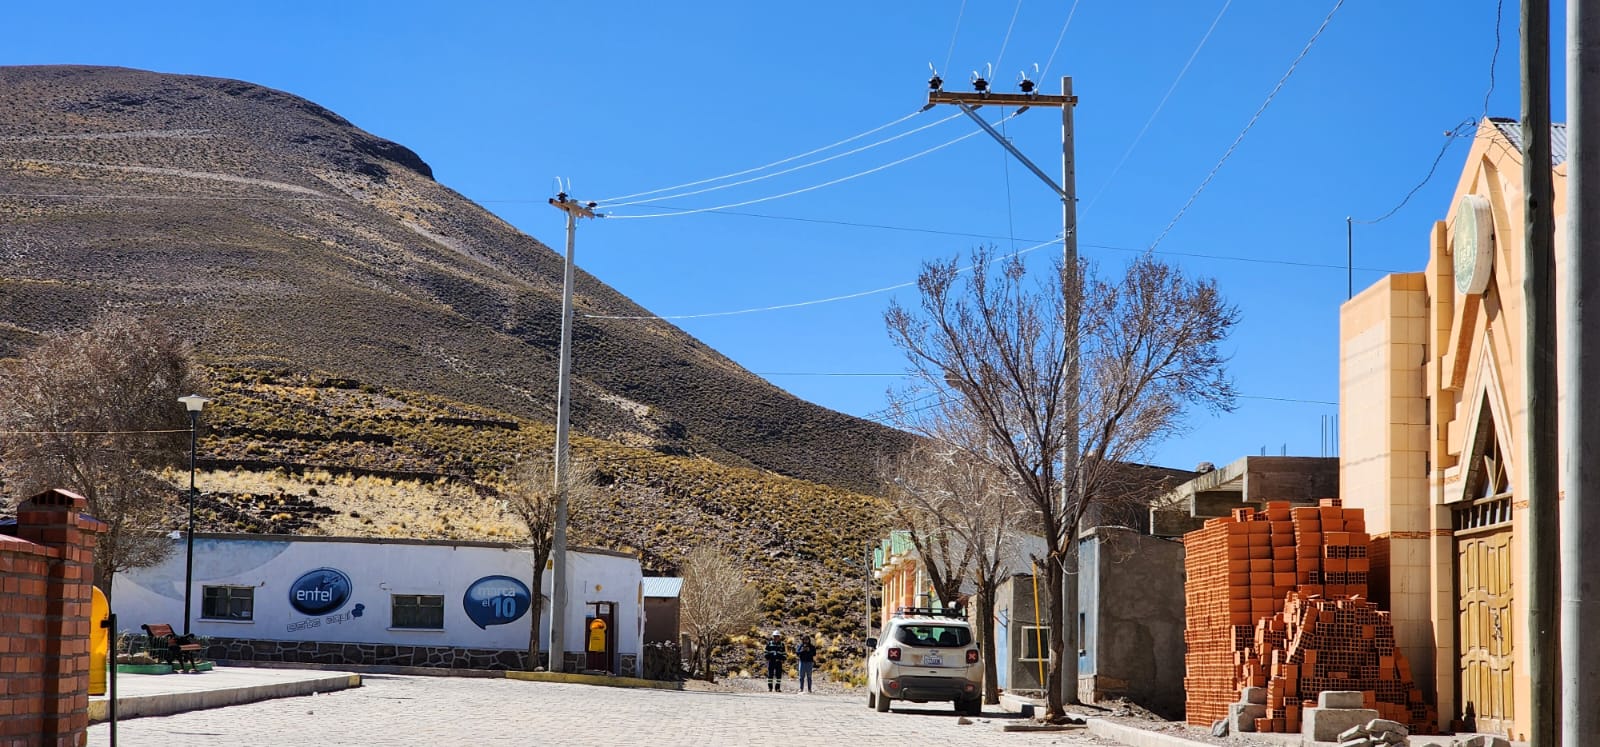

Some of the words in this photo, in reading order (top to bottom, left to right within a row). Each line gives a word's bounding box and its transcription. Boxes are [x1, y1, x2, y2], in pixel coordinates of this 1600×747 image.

[296, 587, 333, 602] entel
[478, 587, 516, 597] marca
[482, 597, 490, 607] el
[491, 597, 516, 618] 10
